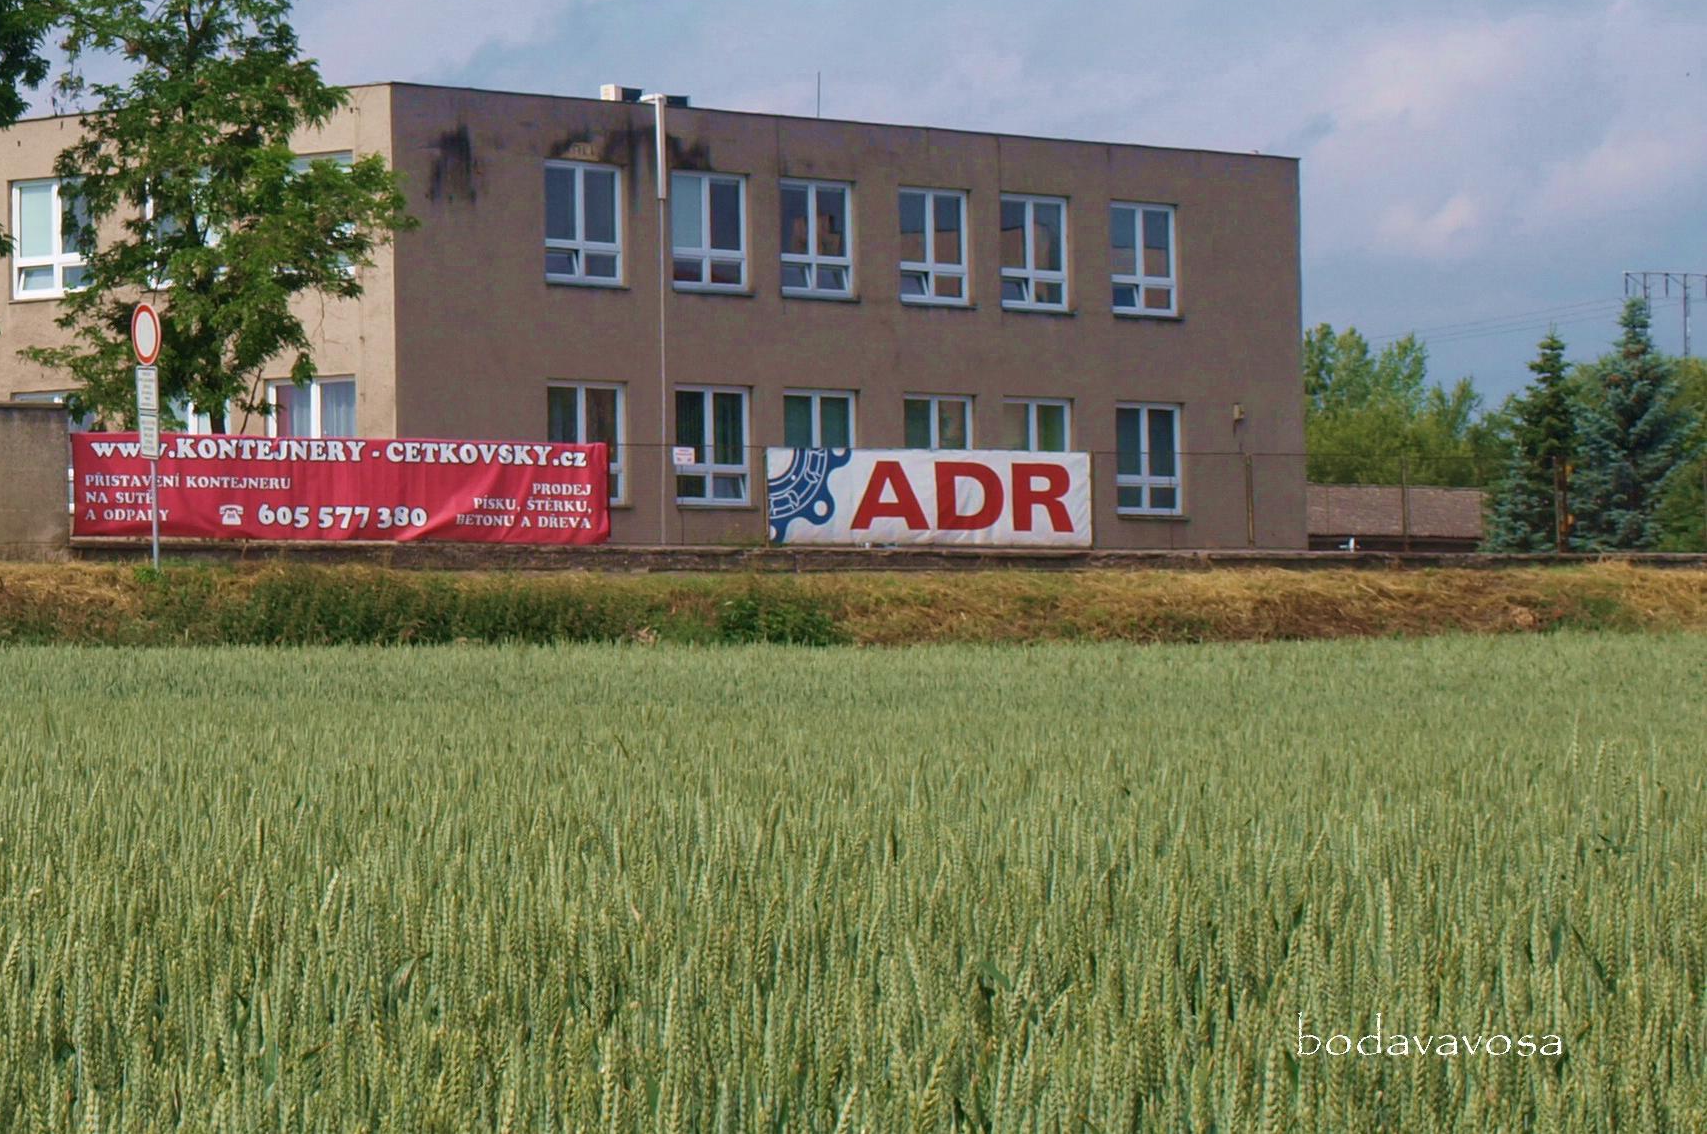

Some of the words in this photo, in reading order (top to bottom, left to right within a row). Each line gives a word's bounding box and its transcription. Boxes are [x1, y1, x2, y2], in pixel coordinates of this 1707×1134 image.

[532, 482, 592, 496] PRODEJ
[850, 460, 1074, 533] ADR
[85, 491, 108, 504] NA
[473, 495, 521, 513] PÍSKU,
[526, 496, 592, 514] ŠTĚRKU,
[85, 509, 96, 521] A
[257, 503, 310, 529] 605
[317, 506, 370, 529] 577
[376, 505, 428, 528] 380
[456, 513, 514, 527] BETONU
[520, 515, 531, 528] A
[538, 514, 592, 529] DŘEVA
